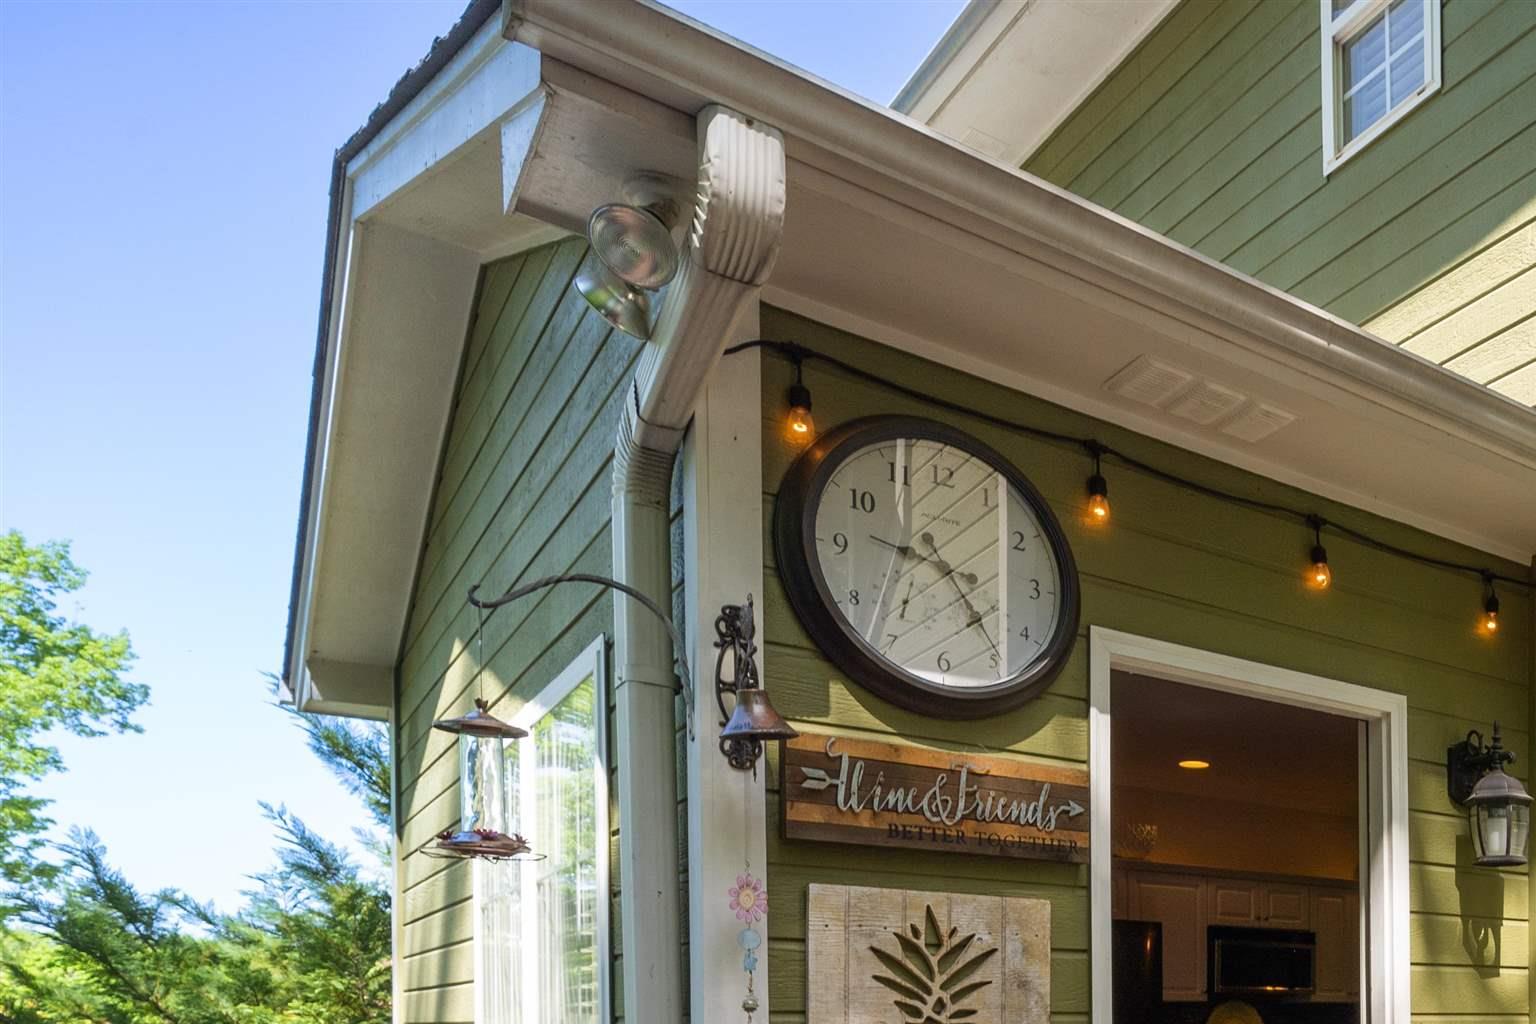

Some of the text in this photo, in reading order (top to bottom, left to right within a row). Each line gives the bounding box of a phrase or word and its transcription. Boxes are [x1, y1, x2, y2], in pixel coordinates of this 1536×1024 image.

[888, 461, 911, 487] 11
[932, 463, 956, 489] 12
[849, 488, 875, 513] 10
[833, 532, 848, 555] 9
[1012, 531, 1026, 552] 2
[849, 588, 860, 606] 8
[1029, 578, 1041, 600] 3
[1019, 626, 1030, 641] 4
[936, 651, 951, 672] 6
[887, 823, 1080, 854] BETTER TOGETHER
